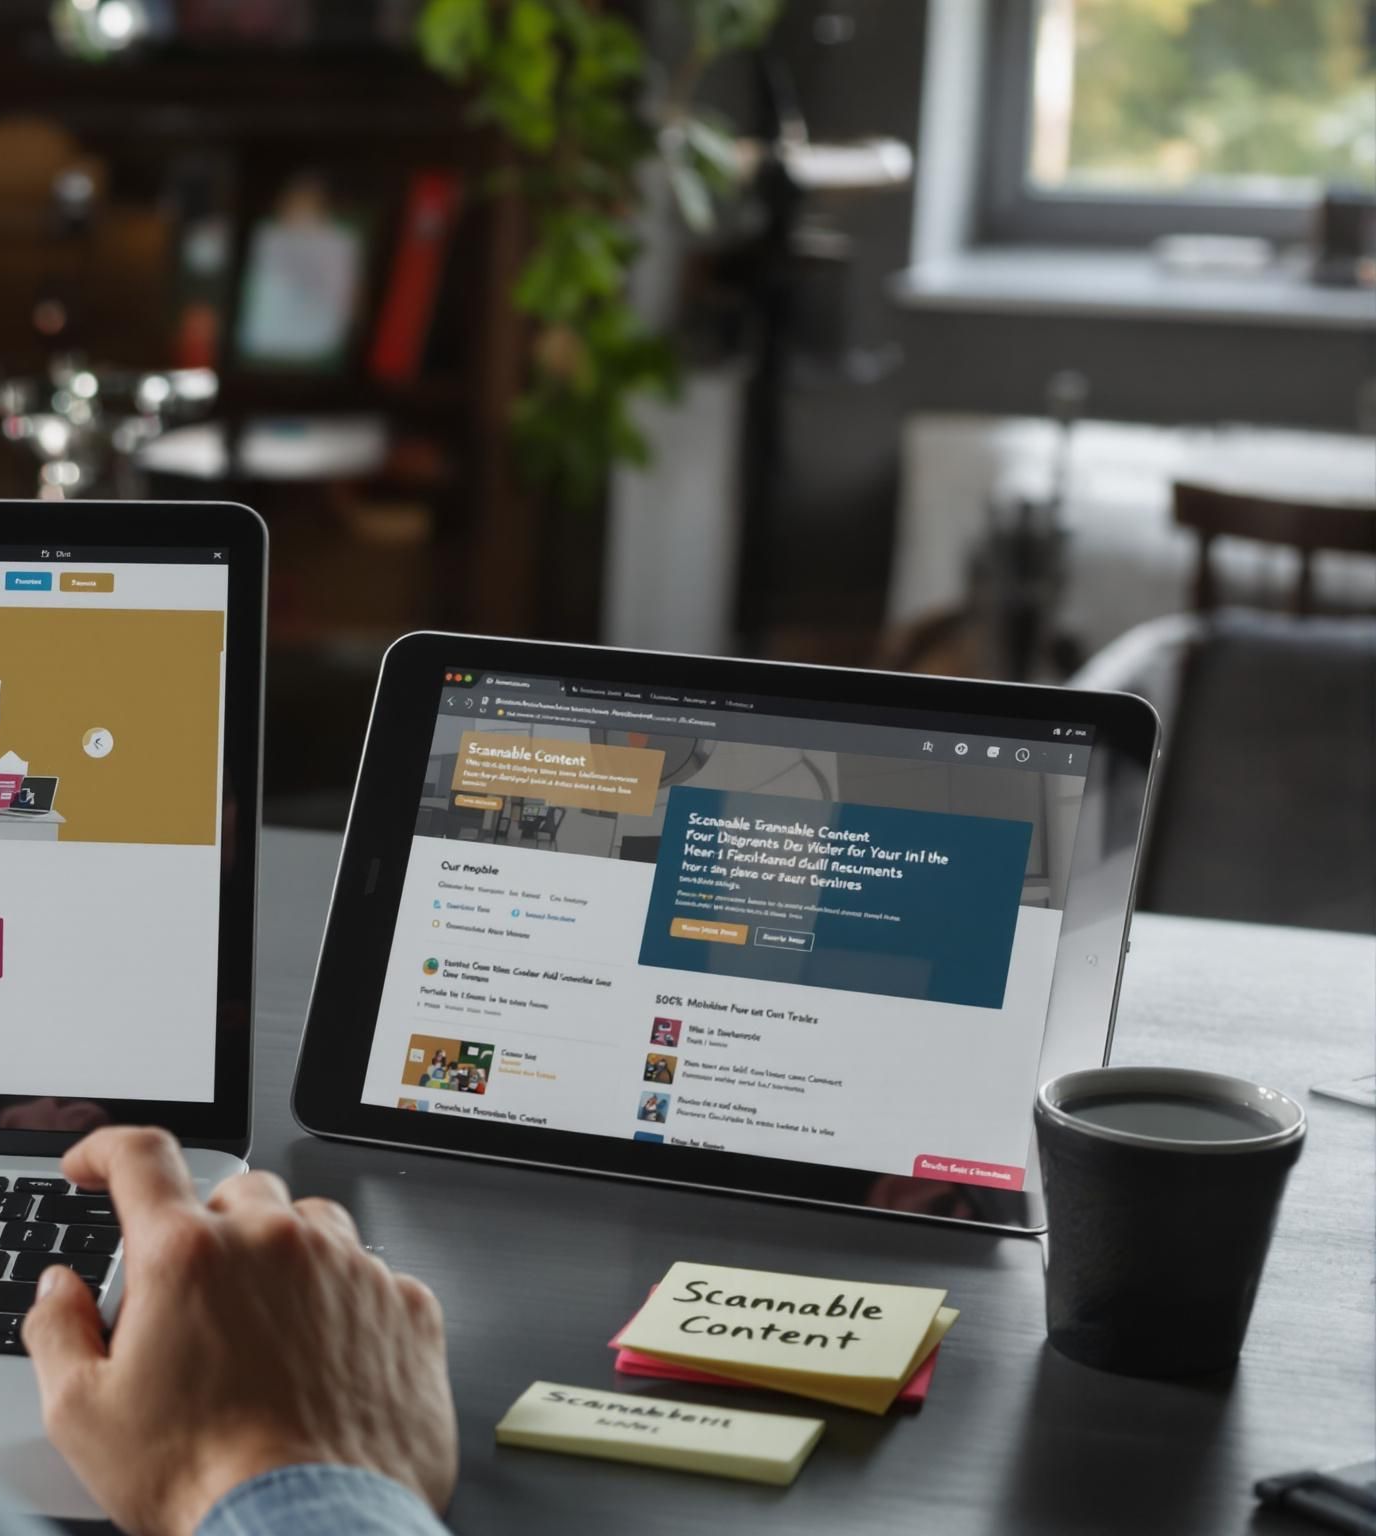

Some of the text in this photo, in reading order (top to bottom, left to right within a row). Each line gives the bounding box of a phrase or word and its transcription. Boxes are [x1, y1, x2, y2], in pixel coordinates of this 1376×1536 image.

[468, 742, 587, 767] Scannable Content
[673, 1281, 883, 1321] Scannable
[679, 1315, 861, 1351] Content
